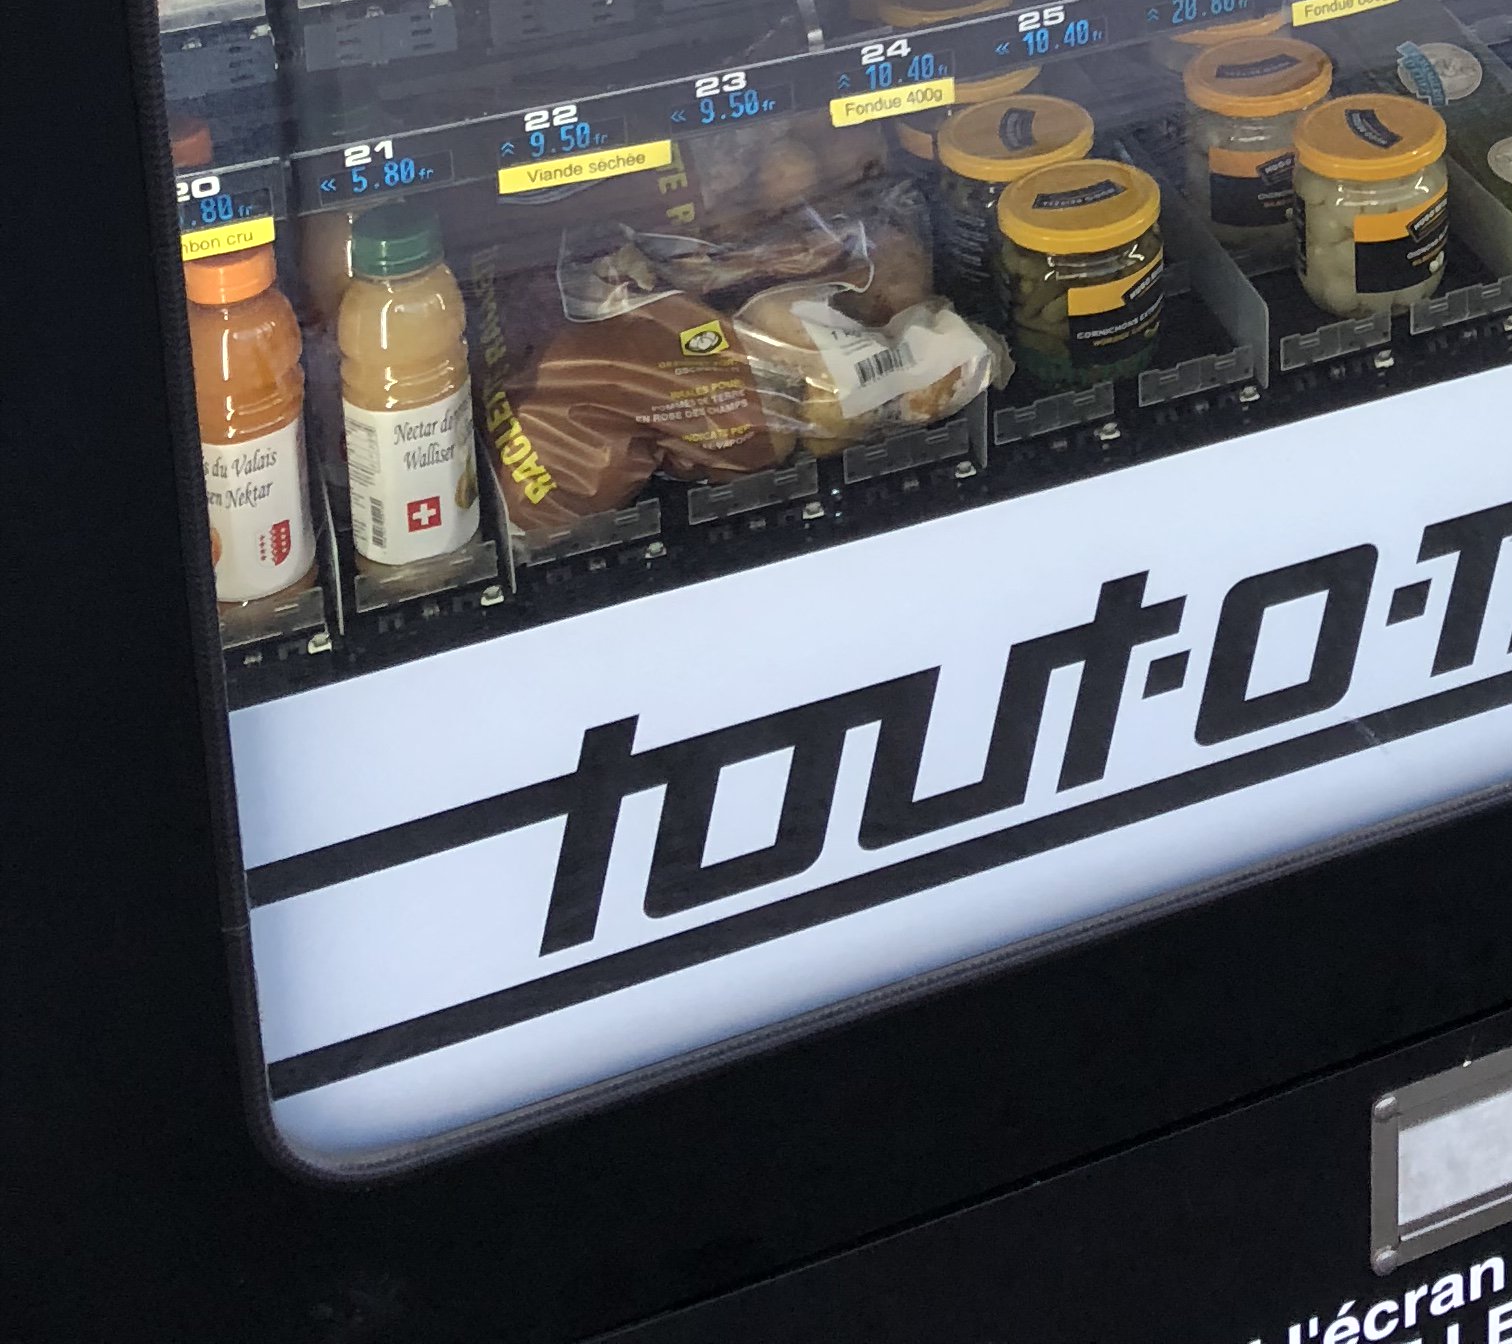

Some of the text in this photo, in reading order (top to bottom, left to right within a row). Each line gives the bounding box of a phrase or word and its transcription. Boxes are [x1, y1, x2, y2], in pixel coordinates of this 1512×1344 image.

[1017, 5, 1066, 32] 25
[860, 38, 912, 65] 24
[1022, 18, 1090, 56] 10.40
[694, 70, 748, 98] 23
[864, 52, 935, 91] 10.40
[699, 88, 759, 124] 9.50
[844, 86, 943, 117] Fondue 400g
[523, 104, 579, 133] 22
[343, 139, 395, 168] 21
[529, 120, 591, 159] 9.50
[351, 157, 416, 194] 5.80
[526, 162, 583, 184] Viande
[226, 229, 255, 247] cru
[393, 418, 439, 446] Nectar
[211, 456, 228, 479] du
[233, 446, 278, 479] Valais
[403, 442, 456, 471] Walliser
[224, 479, 274, 510] Nektar
